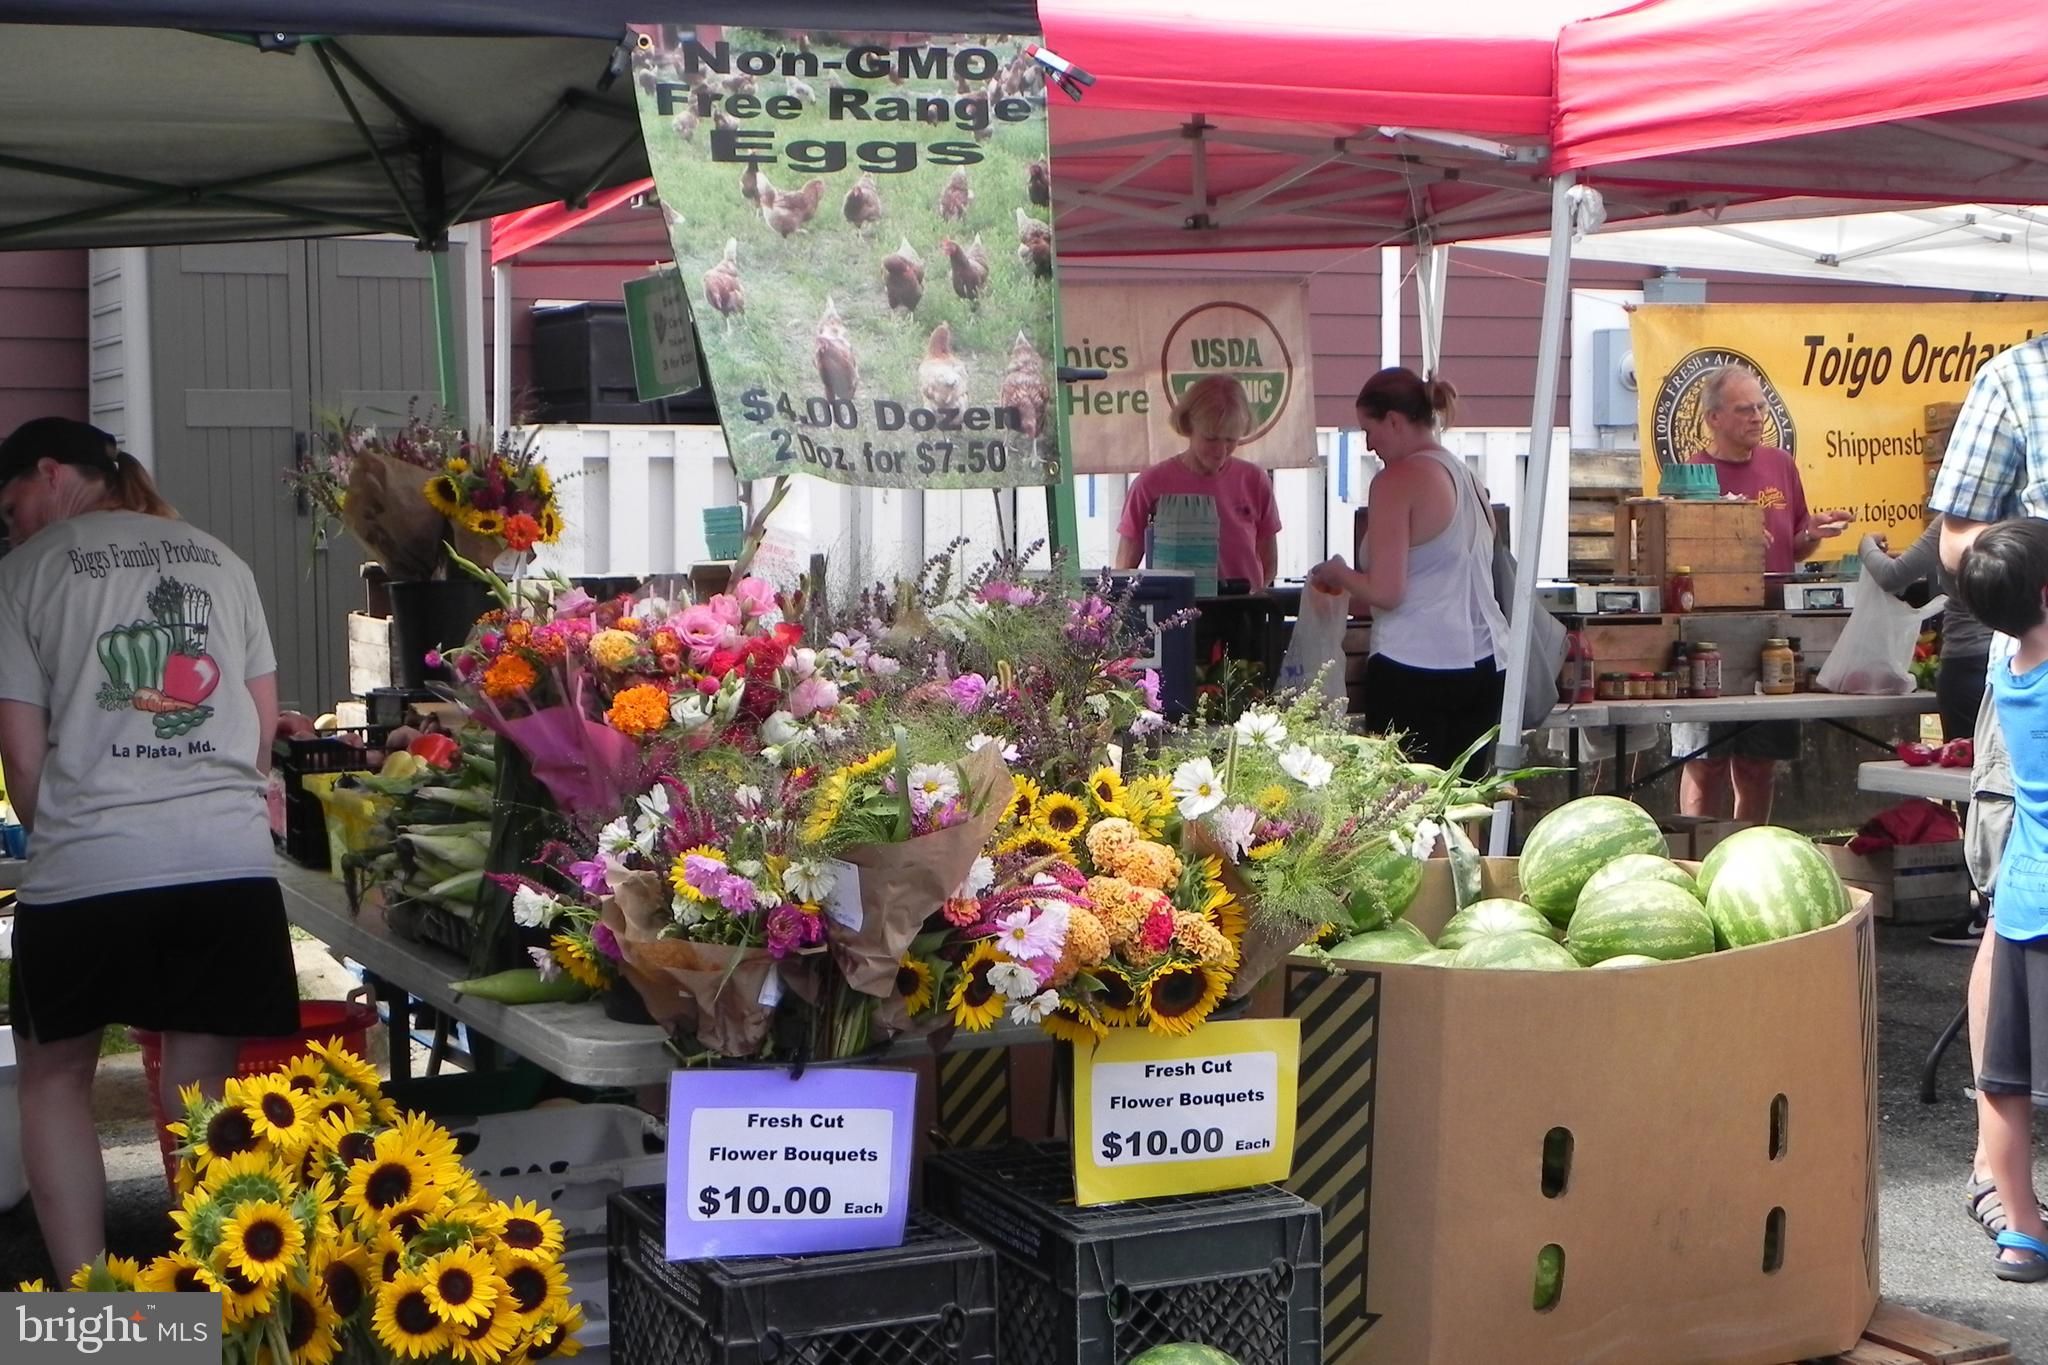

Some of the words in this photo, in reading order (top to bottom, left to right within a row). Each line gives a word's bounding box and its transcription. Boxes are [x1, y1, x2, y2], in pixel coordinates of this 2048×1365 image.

[682, 41, 999, 81] Non-GMO
[656, 82, 804, 121] Free
[828, 87, 1032, 131] Range
[711, 130, 985, 173] Eggs
[1190, 337, 1264, 368] USDA
[1802, 332, 1893, 399] Toigo
[740, 388, 859, 431] $4.00
[874, 399, 1022, 432] Dozen
[1066, 383, 1150, 416] Here
[1656, 400, 1672, 441] 100%
[1665, 356, 1703, 397] FRESH
[770, 428, 797, 462] 2
[797, 433, 856, 471] Doz.
[863, 441, 906, 474] for
[915, 440, 1007, 478] $7.50
[67, 547, 111, 579] Biggs
[108, 541, 161, 574] Family
[160, 538, 222, 567] Produce
[112, 743, 130, 758] La
[136, 743, 182, 759] Plata,
[188, 741, 216, 755] Md.
[1144, 1062, 1196, 1078] Fresh
[1201, 1059, 1233, 1074] Cut
[1110, 1095, 1174, 1110] Flower
[1179, 1088, 1265, 1107] Bouquets
[747, 1113, 803, 1129] Fresh
[810, 1113, 845, 1129] Cut
[709, 1146, 778, 1162] Flower
[783, 1146, 878, 1165] Bouquets
[1101, 1127, 1225, 1161] $10.00
[1235, 1138, 1270, 1151] Each
[698, 1185, 832, 1218] $10.00
[843, 1202, 883, 1214] Each
